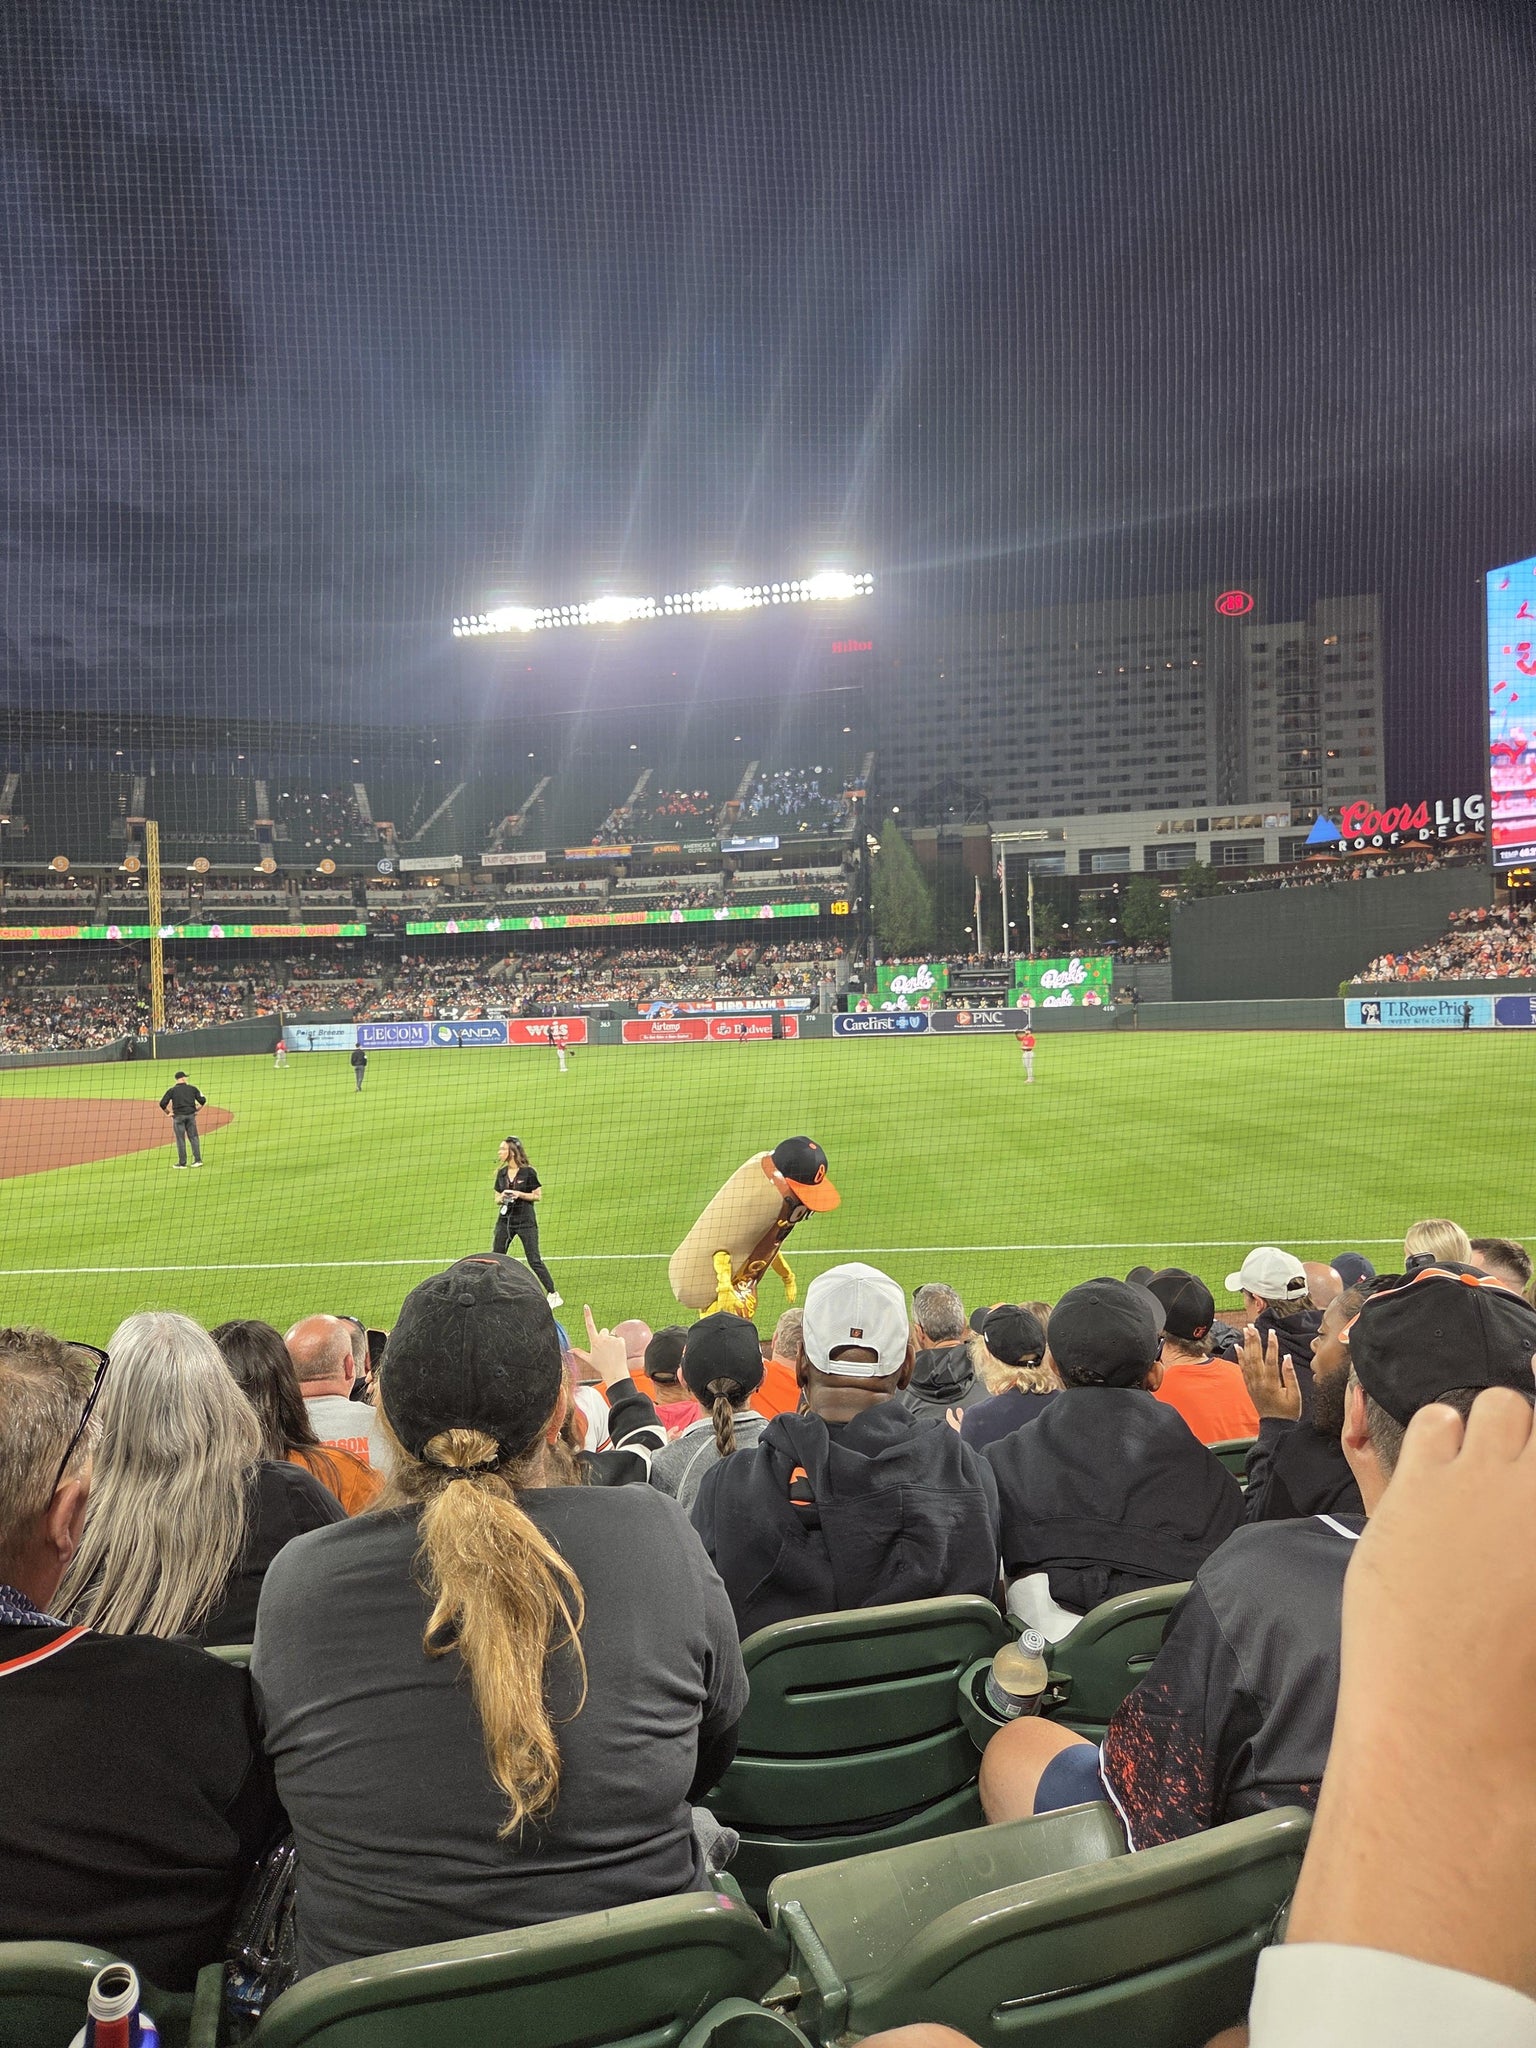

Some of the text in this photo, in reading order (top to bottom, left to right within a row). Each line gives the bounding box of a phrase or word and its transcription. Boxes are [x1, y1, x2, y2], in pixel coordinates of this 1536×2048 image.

[1340, 794, 1485, 838] Coors LIG
[1339, 821, 1485, 851] ROOF DECK
[746, 999, 776, 1009] BATH
[842, 1017, 895, 1031] CareFirst
[972, 1012, 1003, 1023] PNC
[363, 1027, 423, 1041] LECOM
